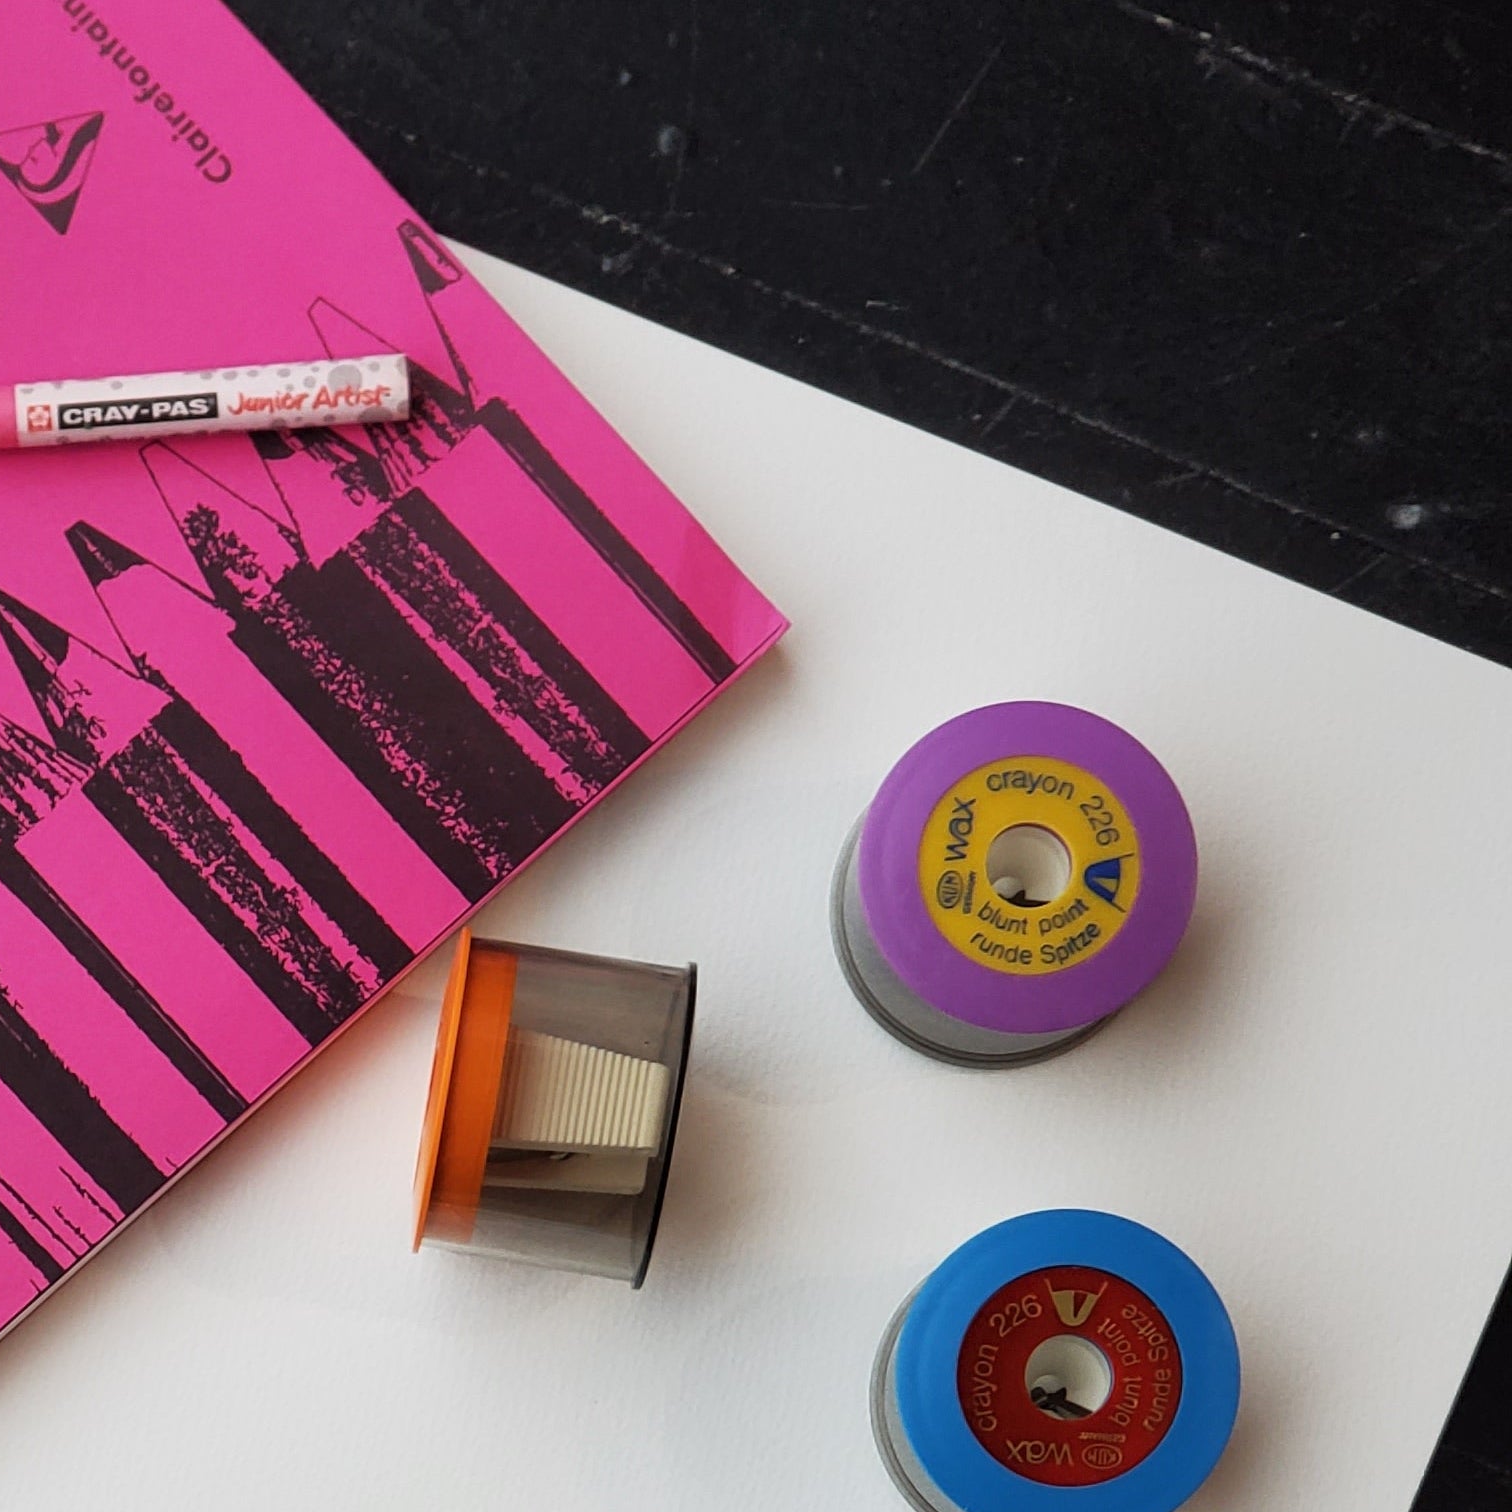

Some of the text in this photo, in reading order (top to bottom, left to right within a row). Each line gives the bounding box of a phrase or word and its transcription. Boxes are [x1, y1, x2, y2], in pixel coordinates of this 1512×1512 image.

[62, 385, 384, 427] CRAY-PAS Junior Artist
[944, 797, 976, 861] wax
[986, 770, 1075, 799] crayon
[1080, 795, 1121, 846] 226
[977, 898, 1090, 936] blunt point
[969, 922, 1102, 965] runde Spitze
[990, 1295, 1042, 1337] 226
[974, 1344, 999, 1431] crayon
[1097, 1317, 1142, 1426] blunt point
[1121, 1303, 1171, 1432] runde Spitze
[1006, 1440, 1074, 1465] wax
